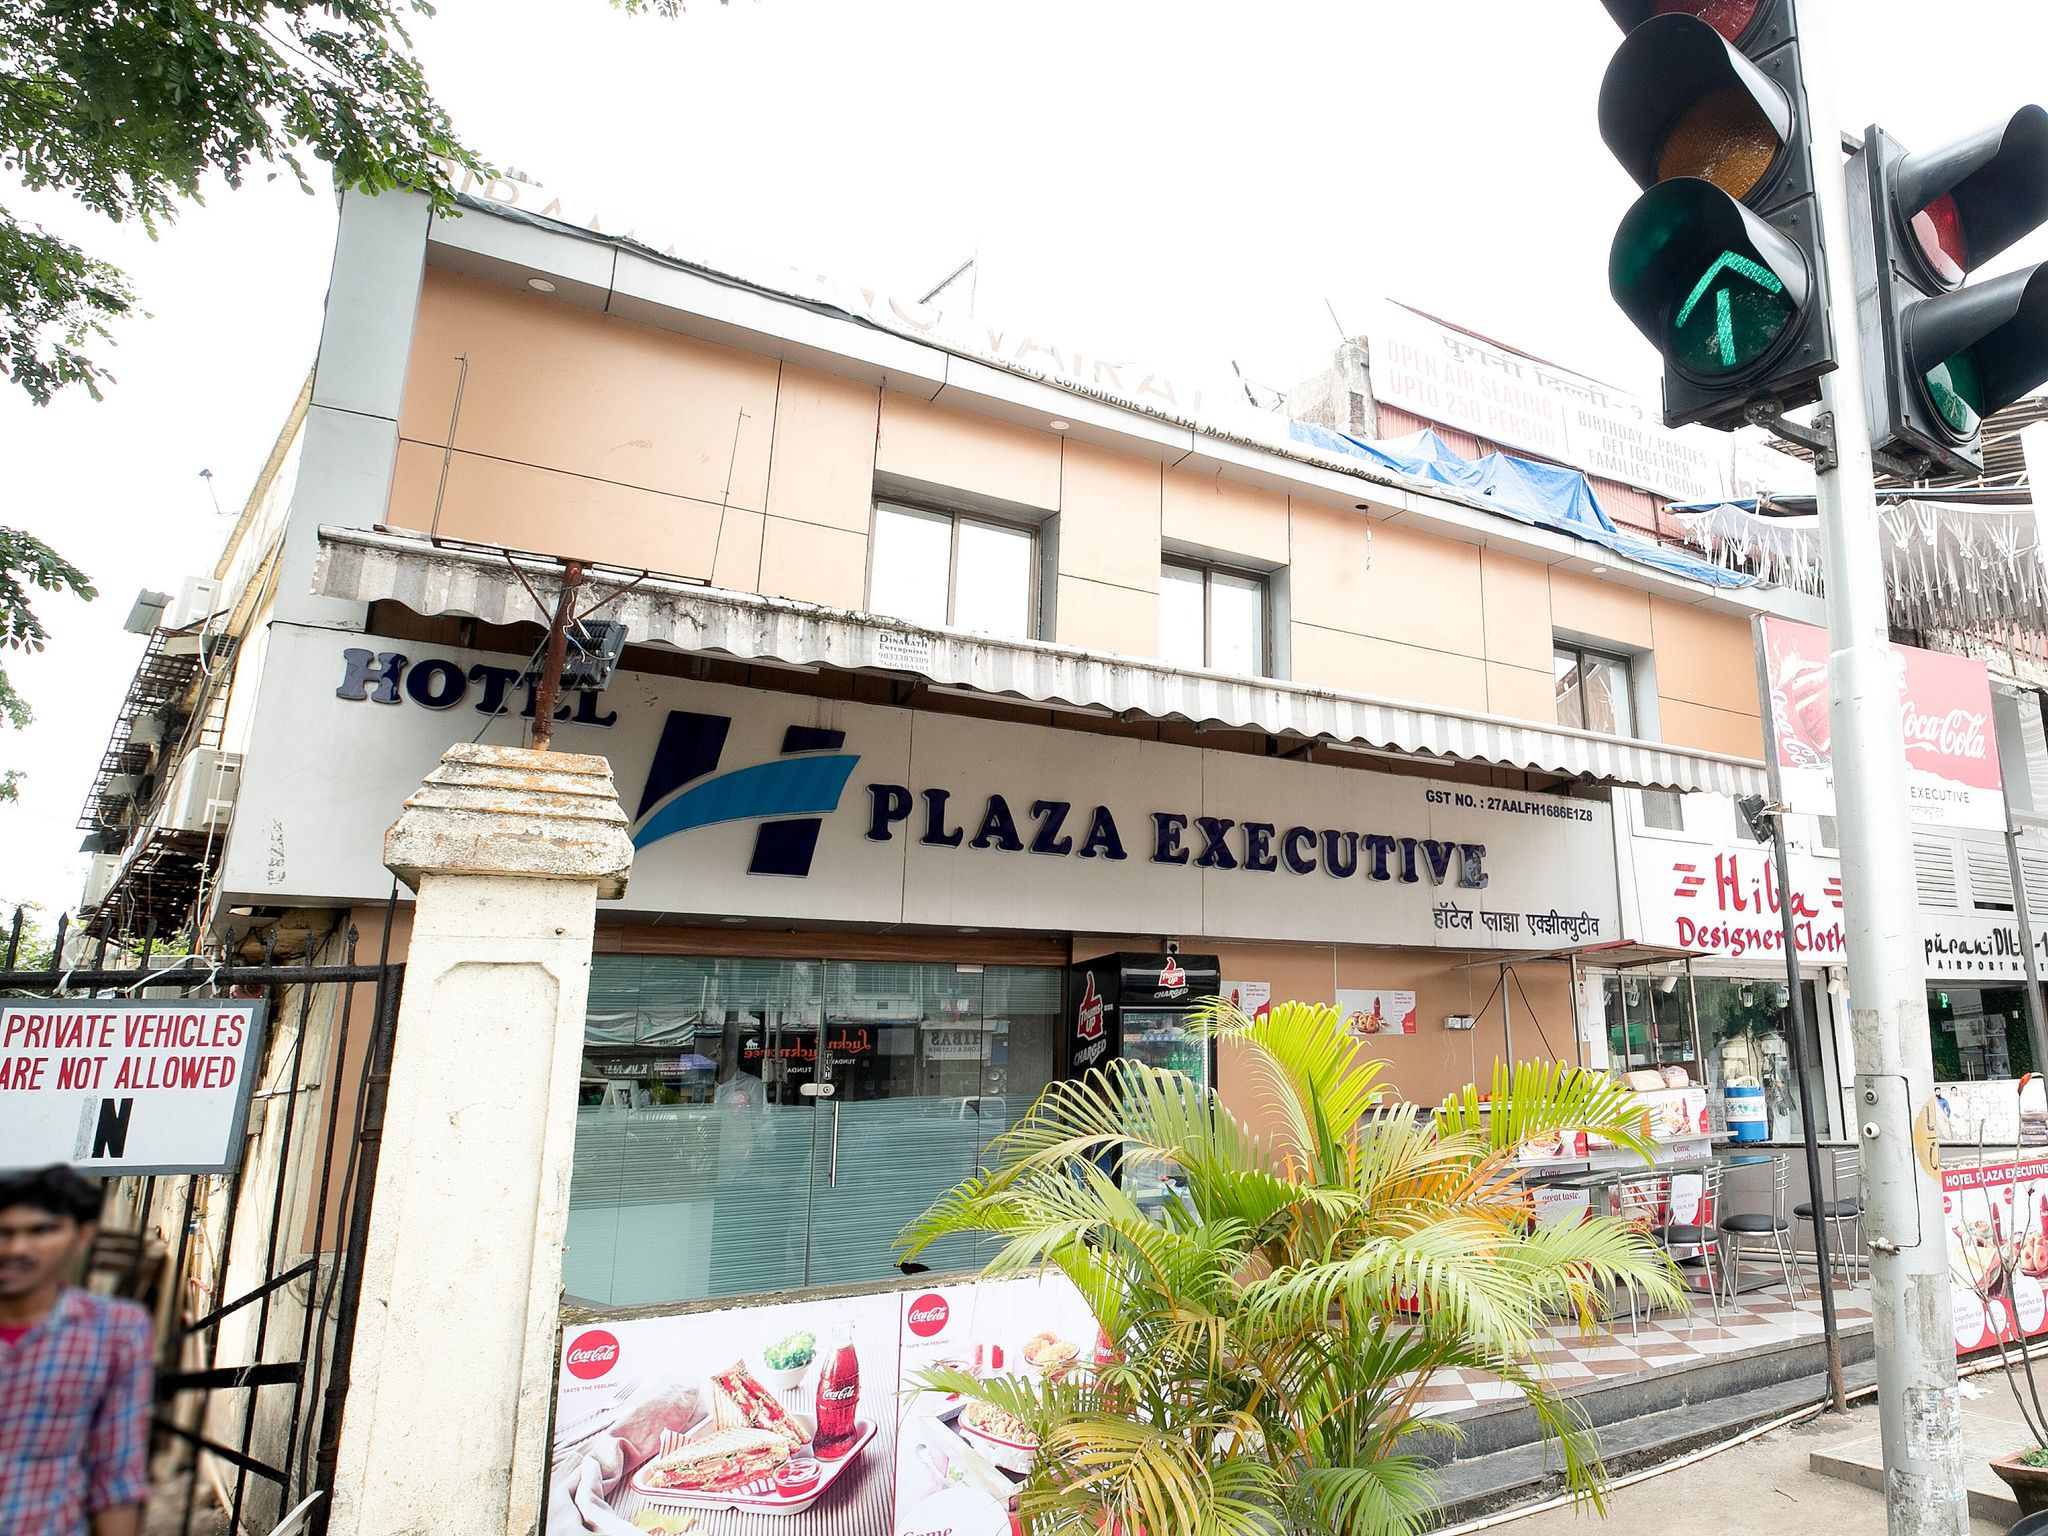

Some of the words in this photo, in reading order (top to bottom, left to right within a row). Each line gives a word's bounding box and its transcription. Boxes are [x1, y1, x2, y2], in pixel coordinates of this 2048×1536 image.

[1387, 338, 1438, 380] OPEN
[1445, 361, 1476, 393] AIR
[1480, 375, 1553, 421] SEATING
[1390, 368, 1439, 409] UPTO
[1445, 390, 1482, 423] 250
[1487, 405, 1556, 449] PERSON
[1577, 409, 1643, 446] BIRTHDAY
[1656, 437, 1708, 469] PARTIES
[1587, 448, 1651, 482] FAMILIES
[1664, 470, 1707, 499] GROUP
[1601, 435, 1626, 456] GET
[1630, 443, 1691, 479] TOGETHER
[1425, 789, 1451, 804] GST
[1487, 797, 1593, 822] 27AALFH1686E1Z8
[1910, 786, 1970, 803] EXECUTIVE
[865, 783, 1127, 860] PLAZA
[1150, 812, 1490, 890] EXECUTIVE
[1675, 916, 1785, 957] Designer
[1938, 960, 2003, 971] AIRPORT
[1153, 987, 1189, 999] CHARGED
[3, 1014, 117, 1048] PRIVATE
[124, 1014, 245, 1048] VEHICLES
[0, 1057, 49, 1090] ARE
[56, 1057, 108, 1090] NOT
[114, 1056, 236, 1089] ALLOWED
[1945, 1172, 1976, 1187] HOTEL
[1976, 1169, 2005, 1183] PLAZA
[909, 1306, 948, 1324] Coca-Cola
[568, 1344, 618, 1365] Coca-Cola
[594, 1382, 618, 1391] FEELING
